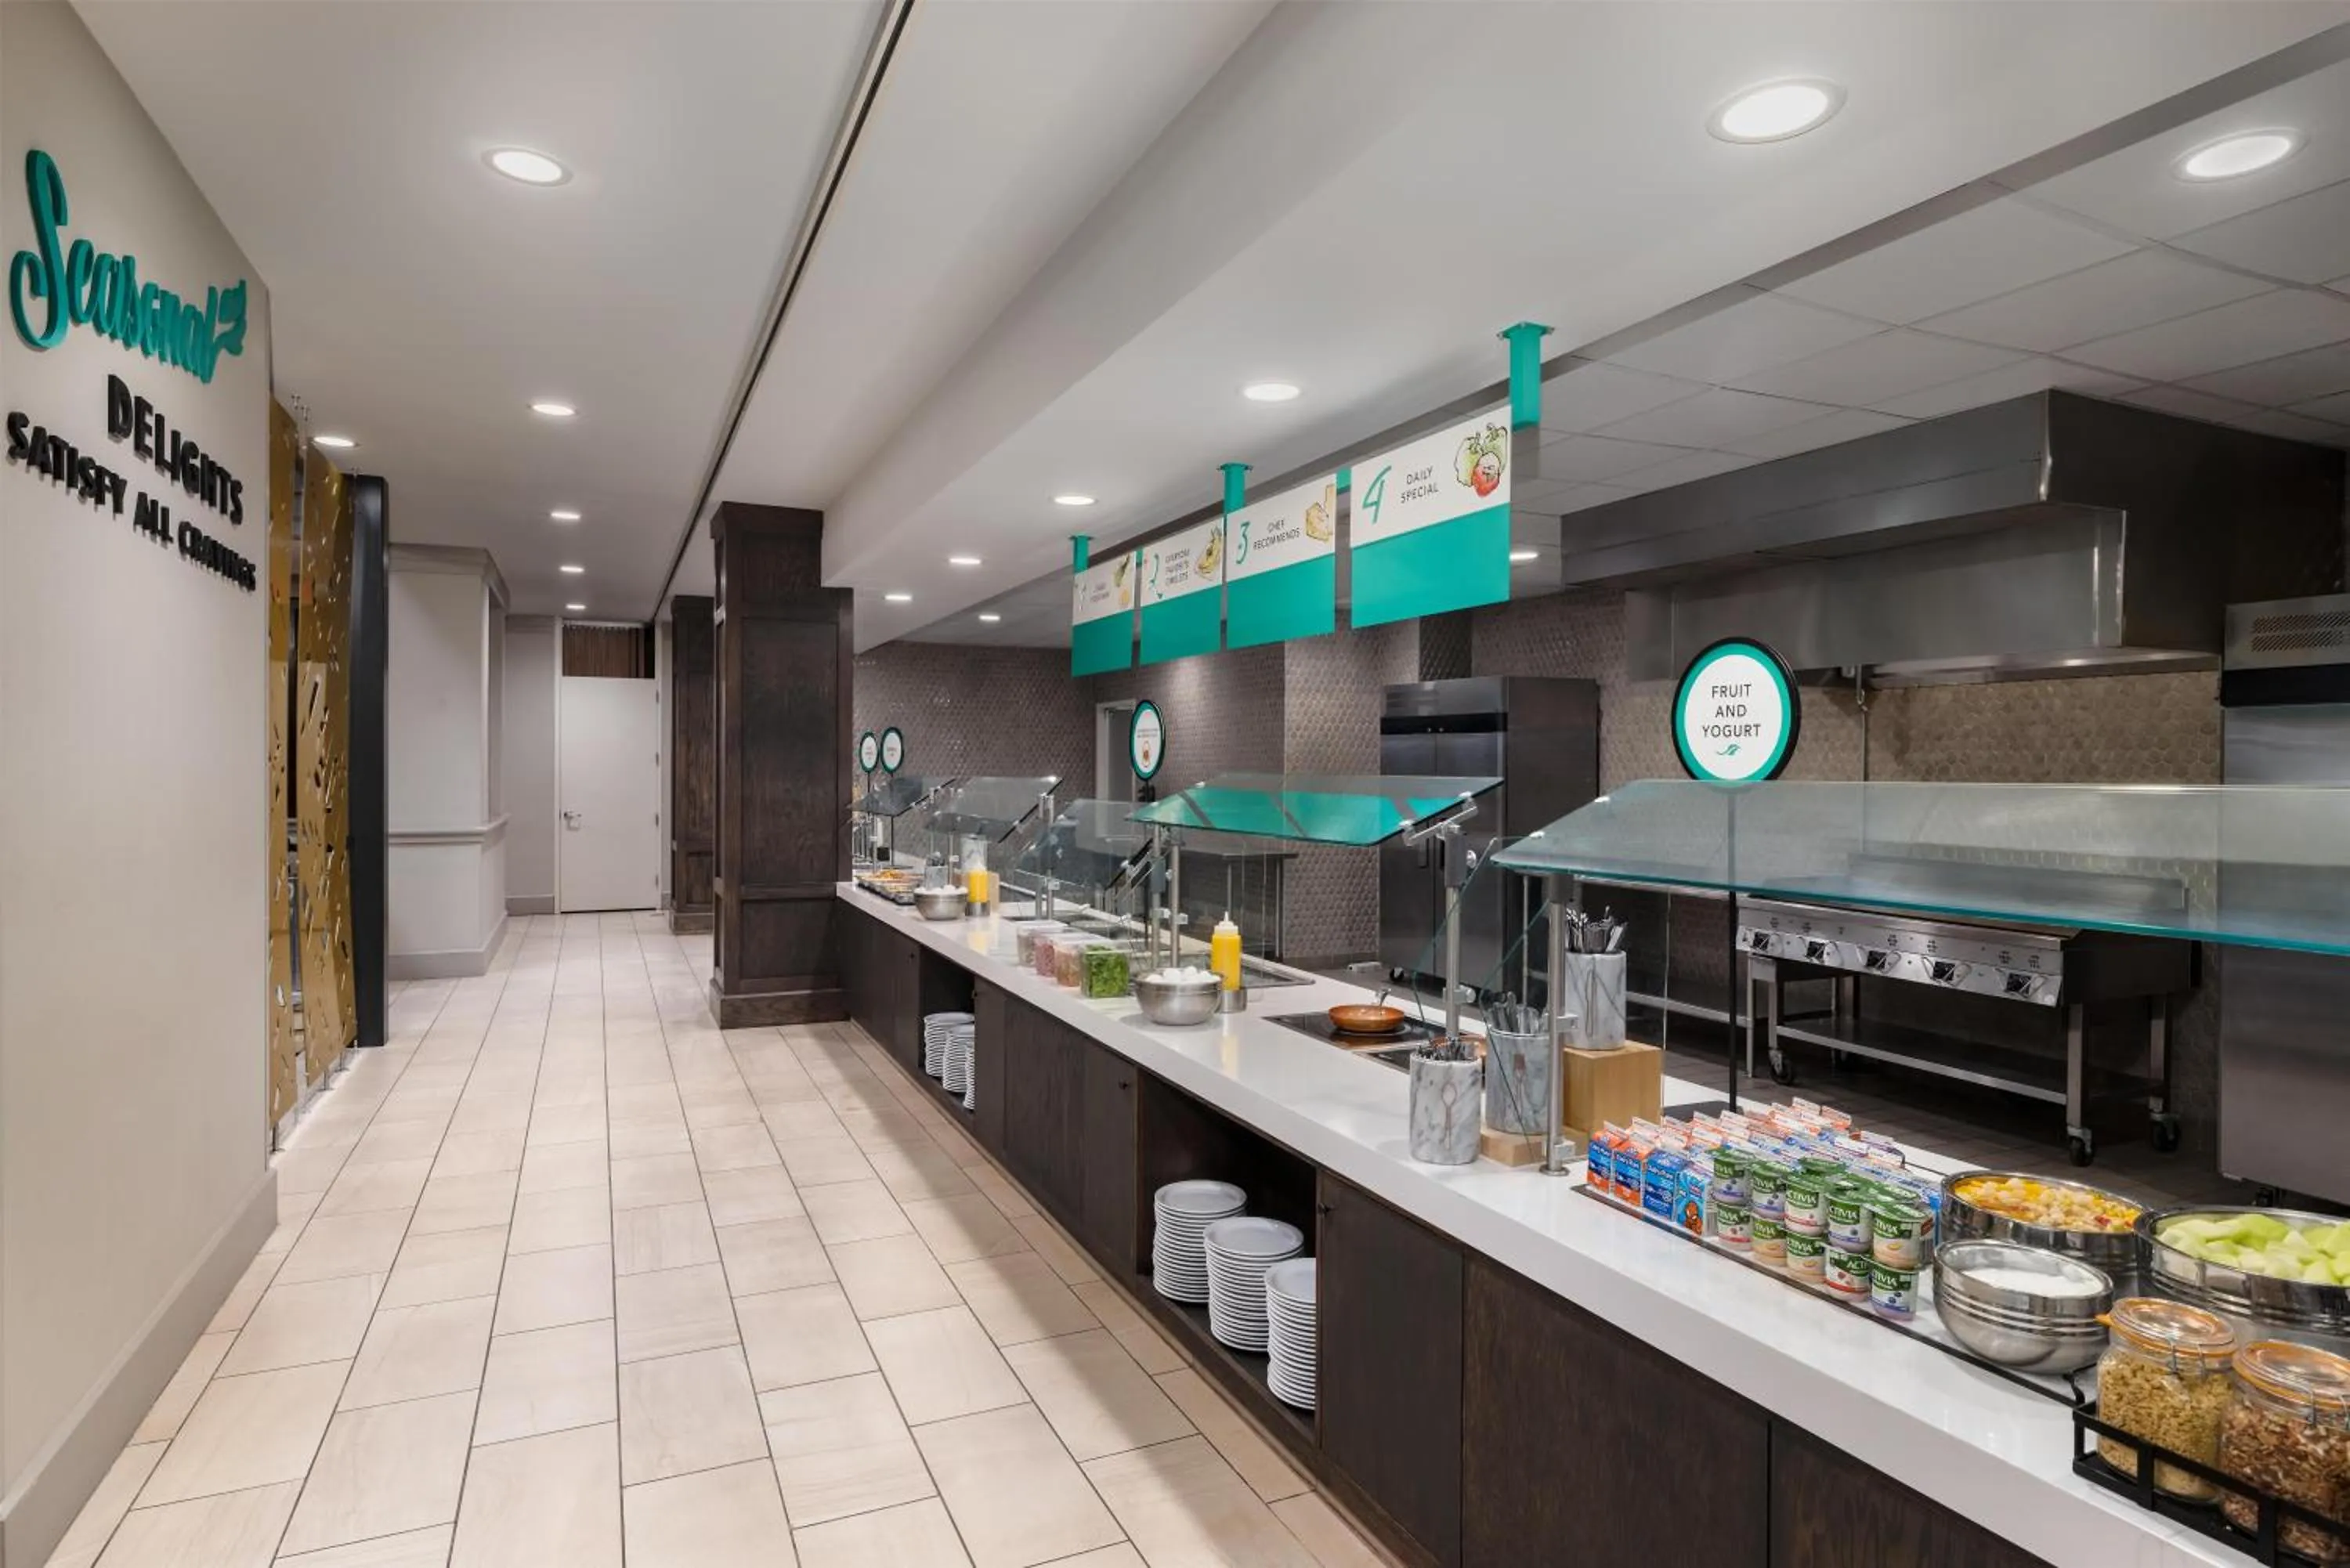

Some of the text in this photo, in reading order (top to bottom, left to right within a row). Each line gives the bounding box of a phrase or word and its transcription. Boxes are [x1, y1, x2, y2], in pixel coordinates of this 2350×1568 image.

[9, 149, 220, 384] Seasonal
[107, 374, 243, 526] DELIGHTS
[7, 411, 127, 515] SATISFY
[133, 491, 173, 544] ALL
[1406, 465, 1434, 486] DAILY
[1362, 464, 1393, 526] 4
[1400, 482, 1440, 504] SPECIAL
[1235, 520, 1251, 565] 3
[1711, 683, 1752, 699] FRUIT
[1715, 704, 1748, 718] AND
[1702, 724, 1762, 739] YOGURT
[1846, 1260, 1867, 1270] ACTI
